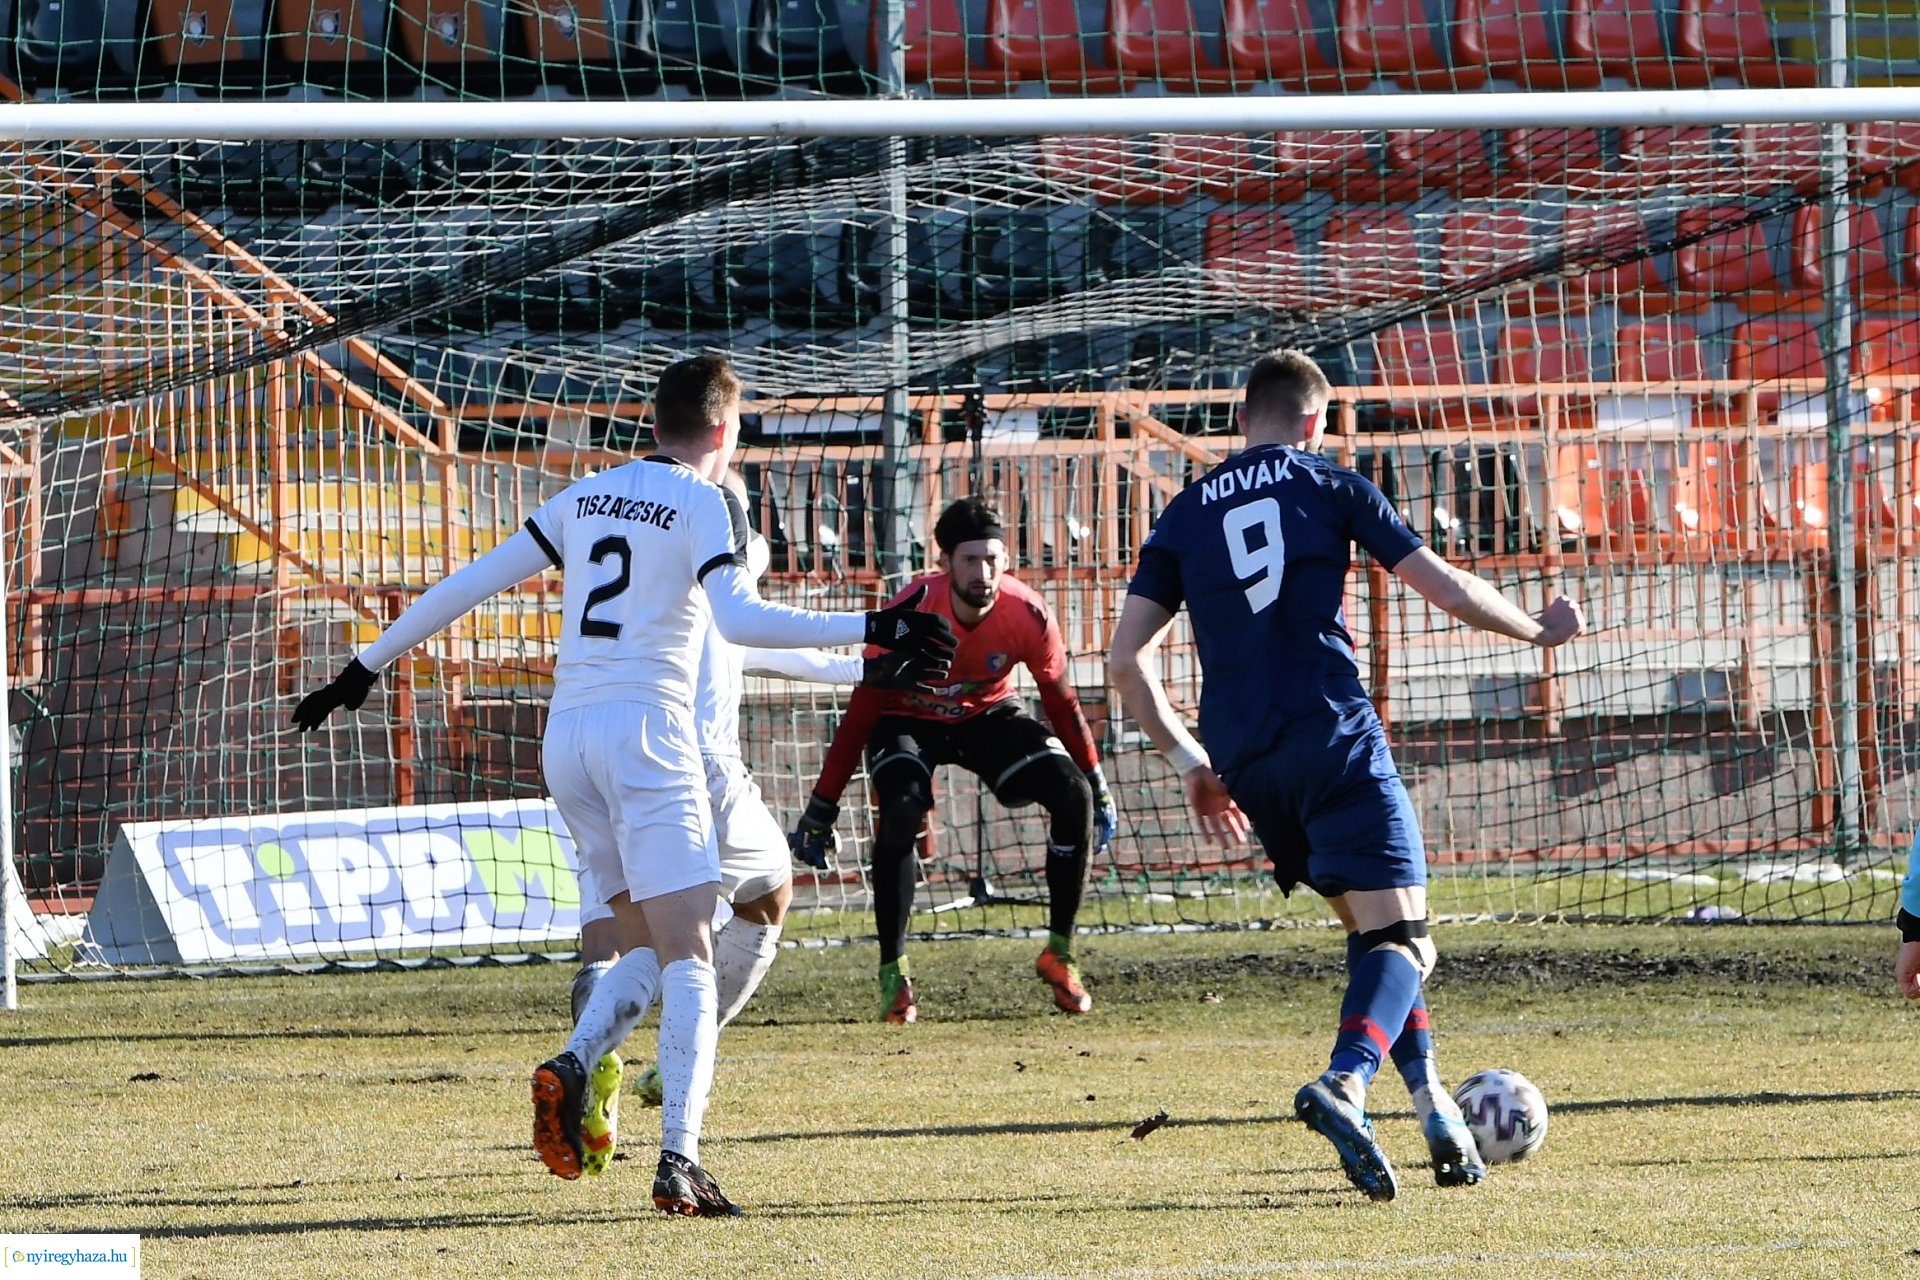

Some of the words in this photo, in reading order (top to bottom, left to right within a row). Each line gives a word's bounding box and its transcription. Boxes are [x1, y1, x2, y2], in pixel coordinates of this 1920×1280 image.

[1202, 456, 1294, 506] NOVÁK
[579, 533, 633, 641] 2
[1222, 496, 1286, 615] 9
